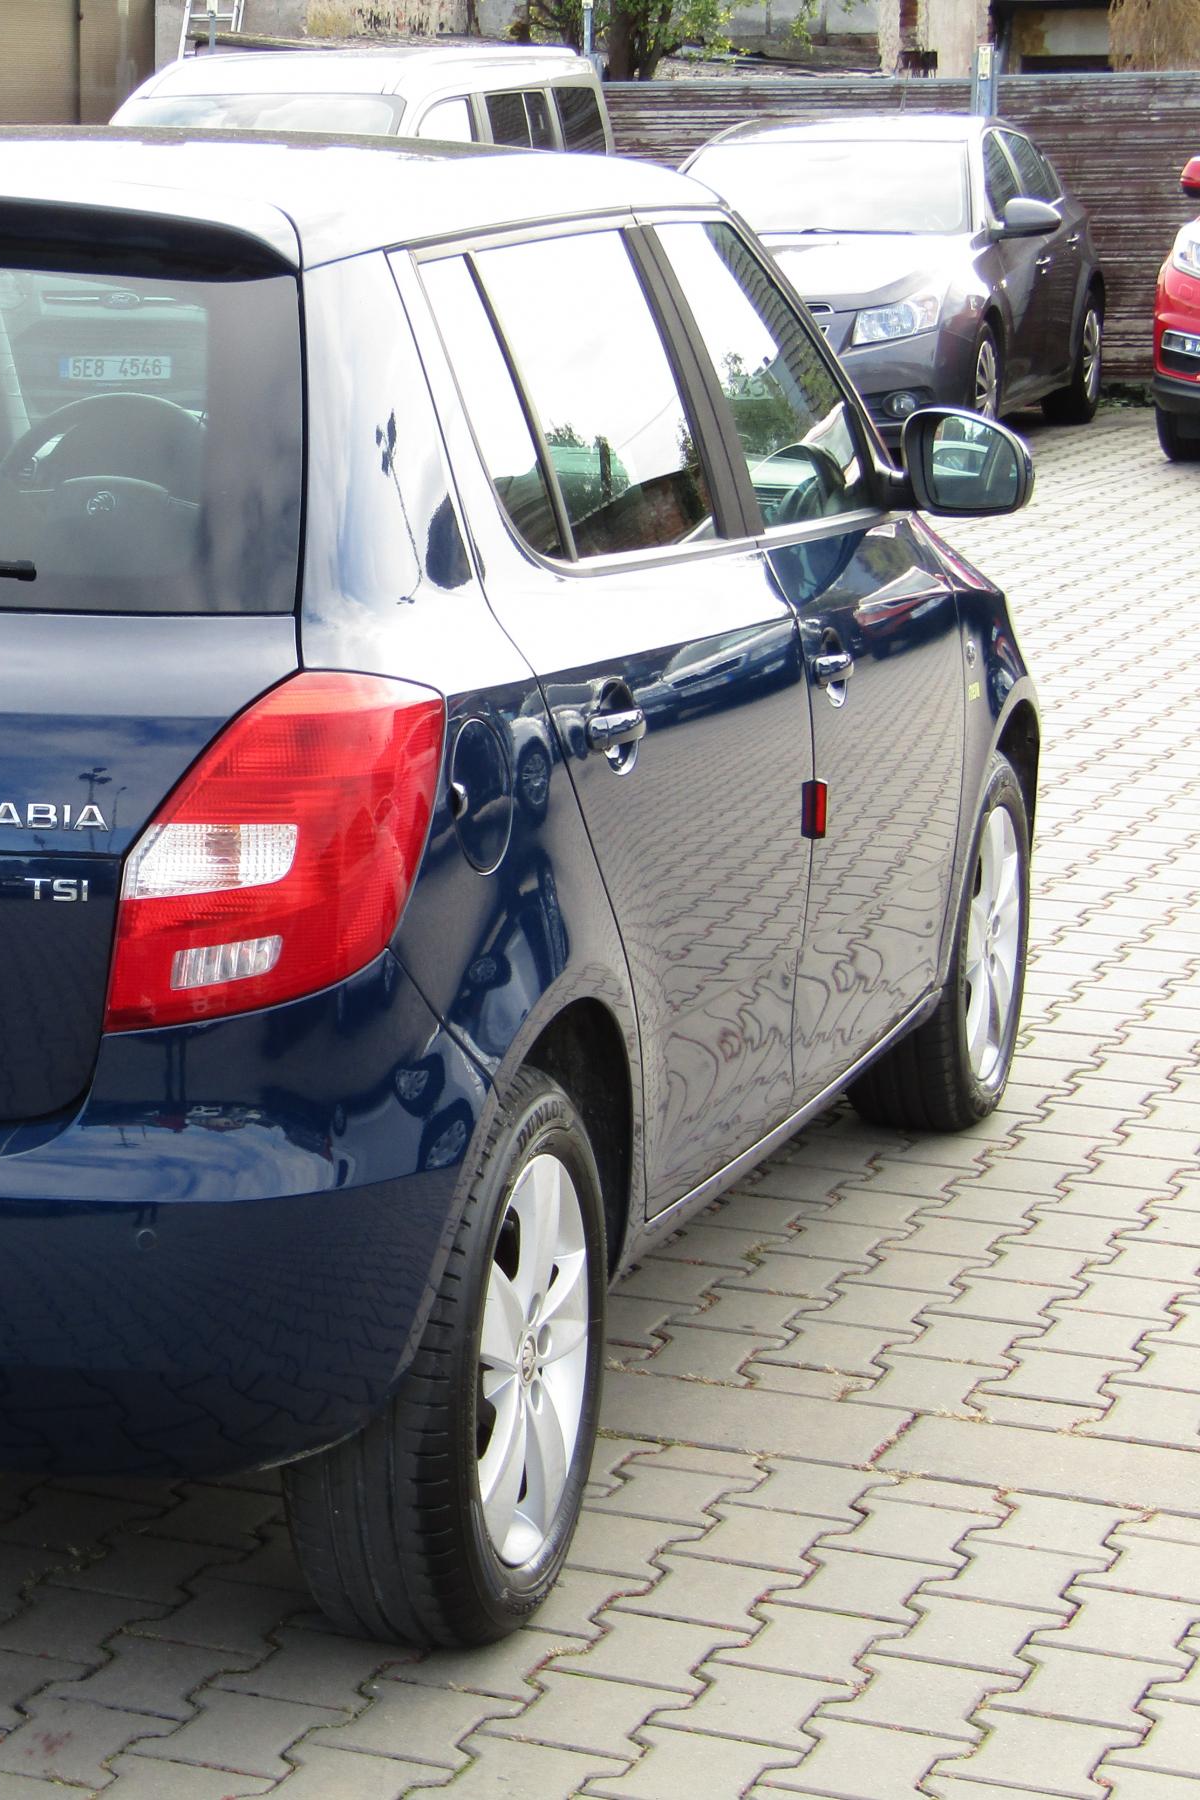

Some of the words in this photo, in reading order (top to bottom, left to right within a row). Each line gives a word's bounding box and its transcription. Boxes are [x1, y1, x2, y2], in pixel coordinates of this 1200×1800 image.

[72, 358, 104, 378] 5E8
[119, 357, 162, 377] 4546
[24, 877, 88, 902] TSI
[516, 1100, 567, 1154] DUNLOP
